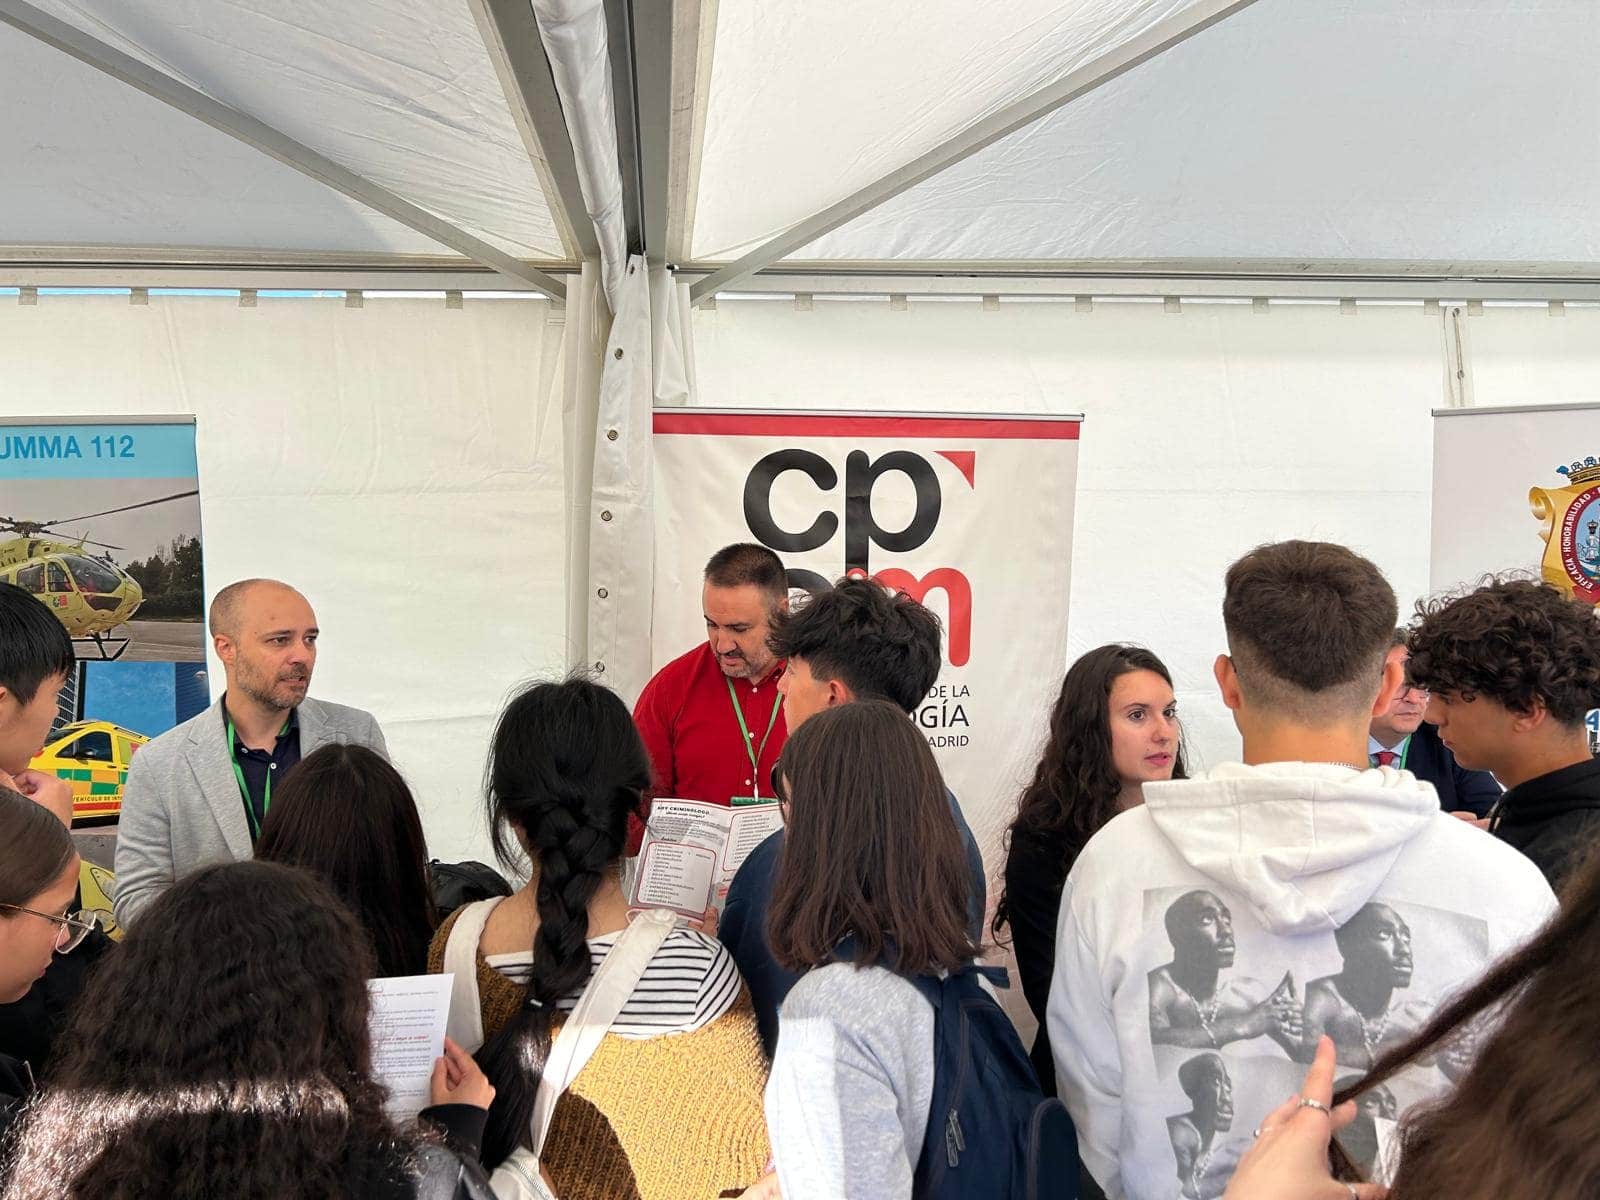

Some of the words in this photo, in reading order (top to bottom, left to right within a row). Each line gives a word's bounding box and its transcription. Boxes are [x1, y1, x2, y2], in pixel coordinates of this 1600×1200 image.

[91, 435, 135, 458] 112
[743, 448, 942, 579] cp
[1563, 493, 1592, 553] HONORABILIDAD
[1564, 558, 1594, 590] EFICACIA
[928, 685, 947, 698] DE
[952, 684, 970, 698] LA
[912, 698, 970, 729] GÍA
[928, 735, 969, 748] ADRID
